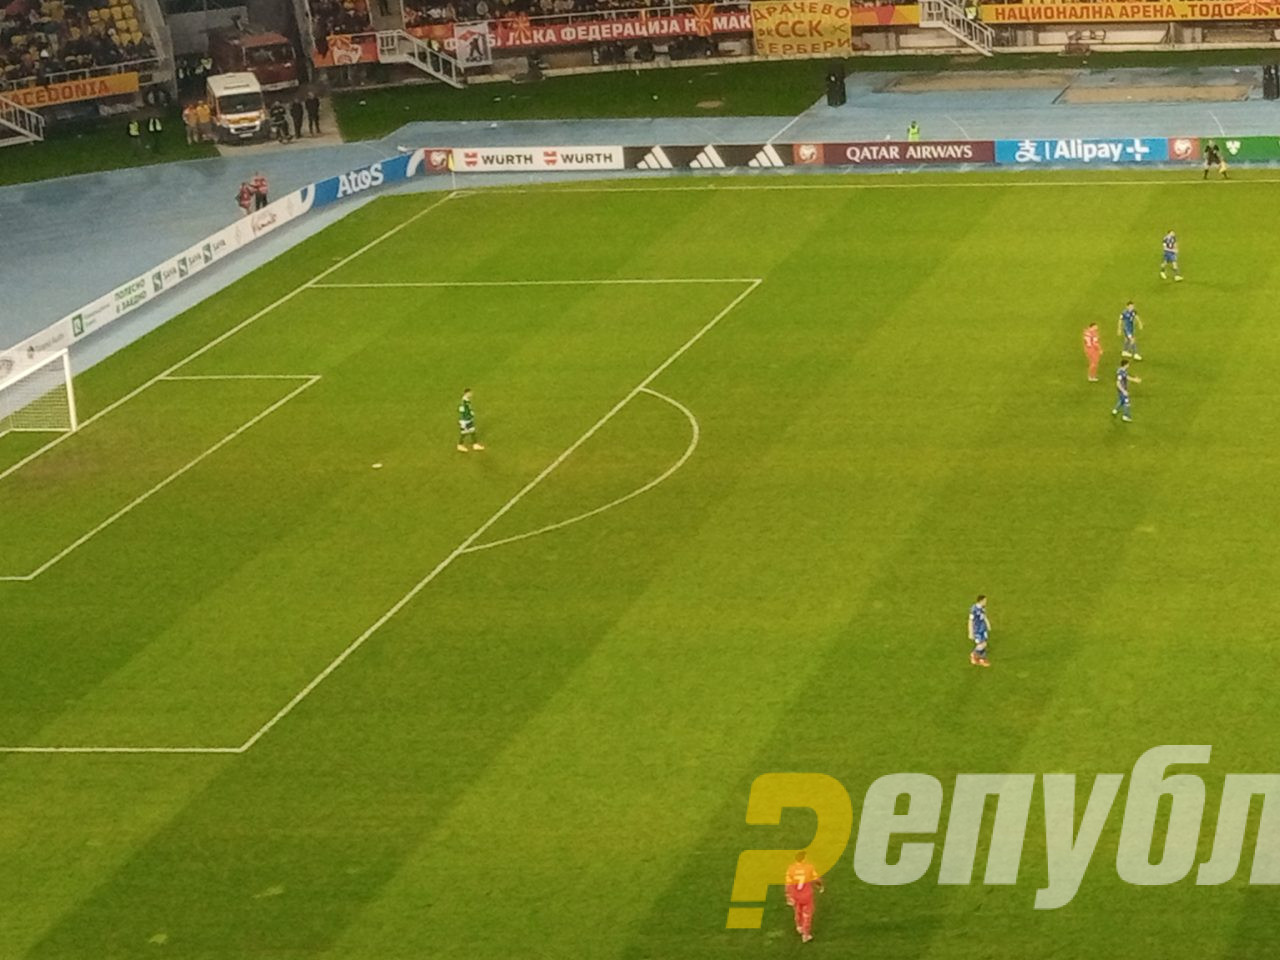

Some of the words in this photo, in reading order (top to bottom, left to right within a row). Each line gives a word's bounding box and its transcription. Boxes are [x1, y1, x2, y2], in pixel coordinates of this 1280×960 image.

[752, 2, 850, 20] ДРАЧЕВО
[995, 6, 1114, 21] НАЦИОНАЛНА
[1119, 4, 1176, 17] АРЕНА
[1181, 3, 1246, 18] „ТОДО
[560, 19, 681, 41] ФЕДЕРАЦИЈА
[712, 14, 752, 30] МАК
[775, 20, 824, 38] ССК
[0, 80, 111, 110] ACEDONIA
[846, 145, 900, 161] QATAR
[906, 144, 973, 159] AIRWAYS
[793, 874, 806, 890] 7
